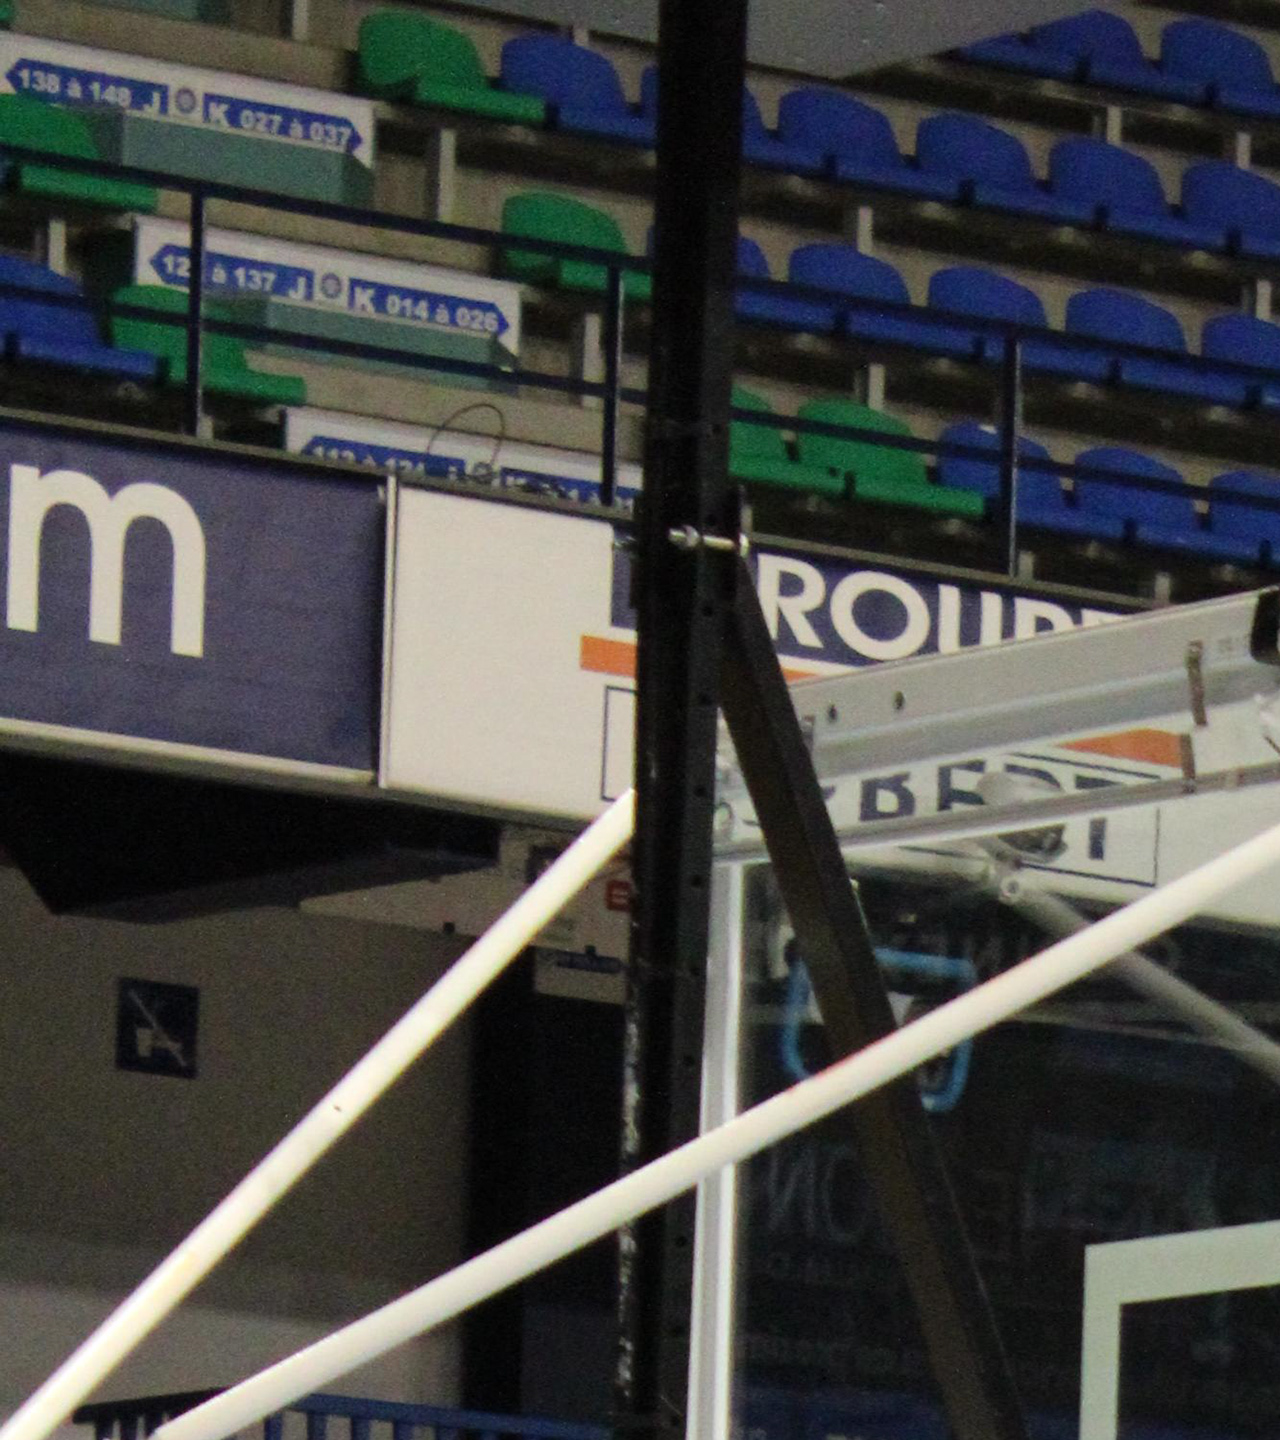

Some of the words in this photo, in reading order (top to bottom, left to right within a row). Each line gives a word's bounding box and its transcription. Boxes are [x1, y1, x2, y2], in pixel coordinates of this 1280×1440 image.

[144, 92, 161, 116] J
[208, 102, 232, 128] K
[240, 110, 282, 133] 027
[310, 123, 351, 146] 037
[164, 255, 191, 277] 12
[235, 267, 276, 291] 137
[289, 276, 306, 300] J
[354, 287, 377, 314] K
[387, 295, 428, 320] 014
[456, 309, 498, 332] 026
